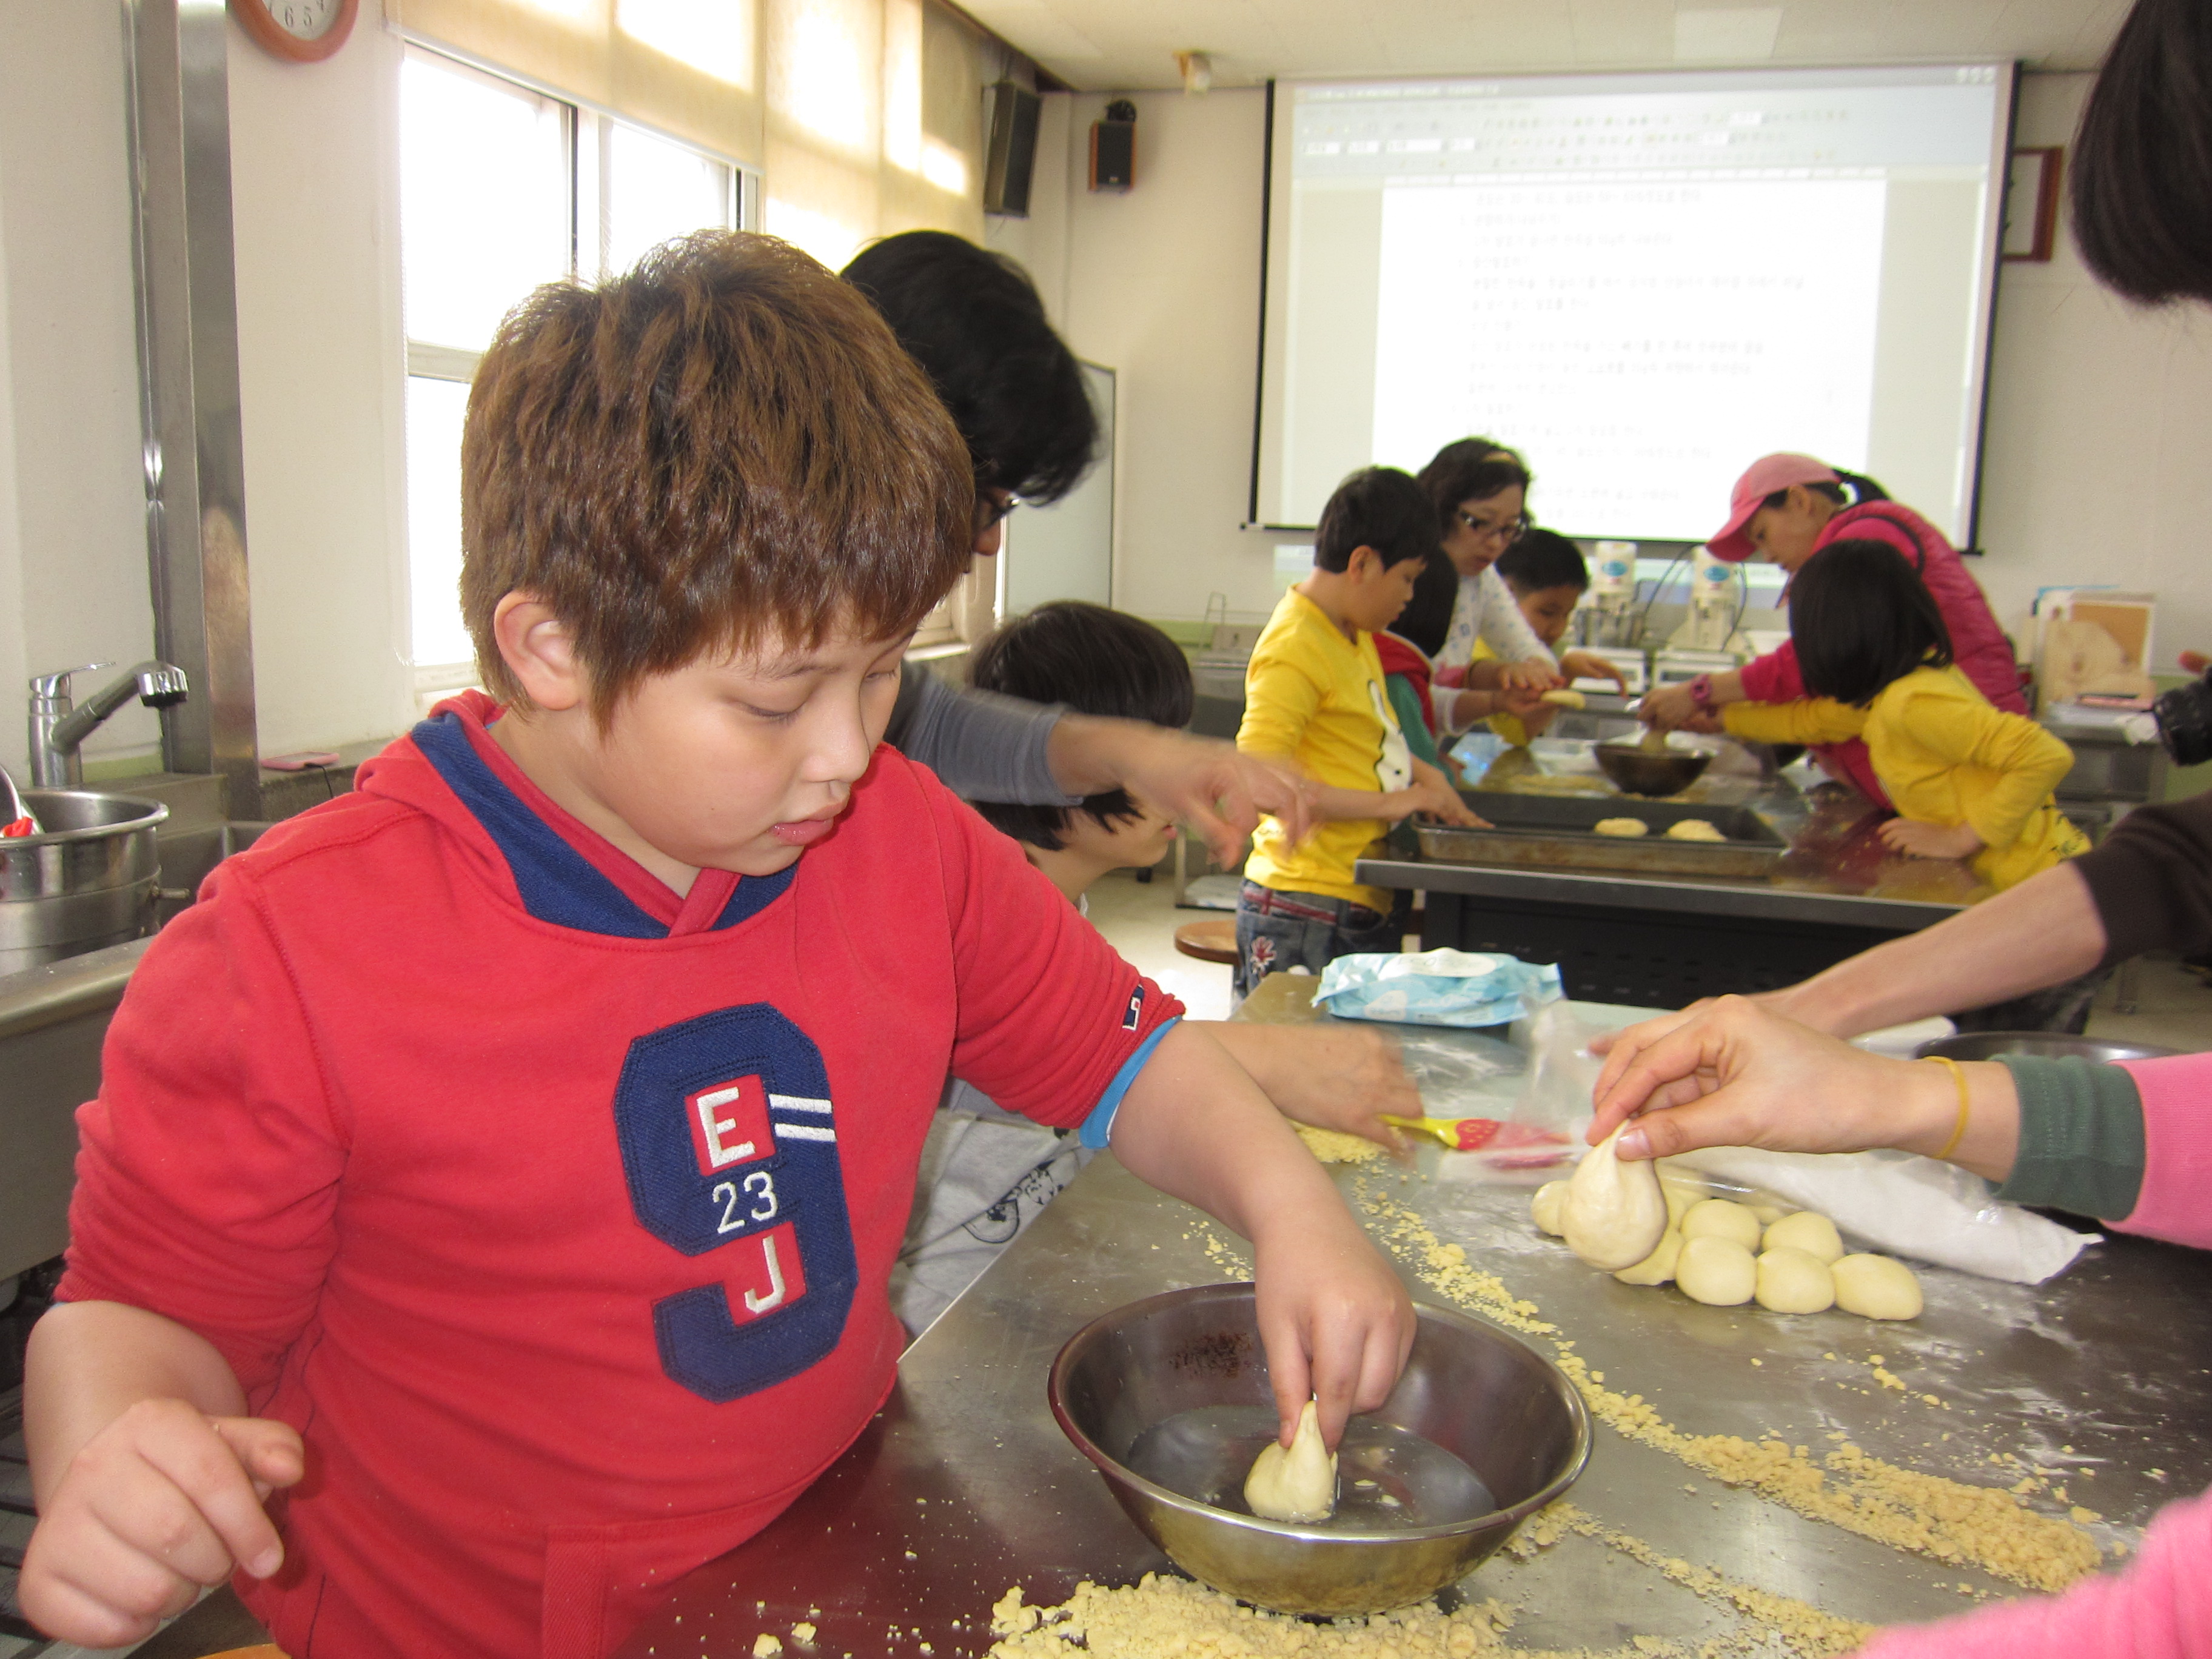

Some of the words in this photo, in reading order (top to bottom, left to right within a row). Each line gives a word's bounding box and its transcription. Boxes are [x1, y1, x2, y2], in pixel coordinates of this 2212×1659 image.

[696, 1087, 756, 1168] E
[712, 1171, 779, 1235] 23
[744, 1235, 786, 1315] J
